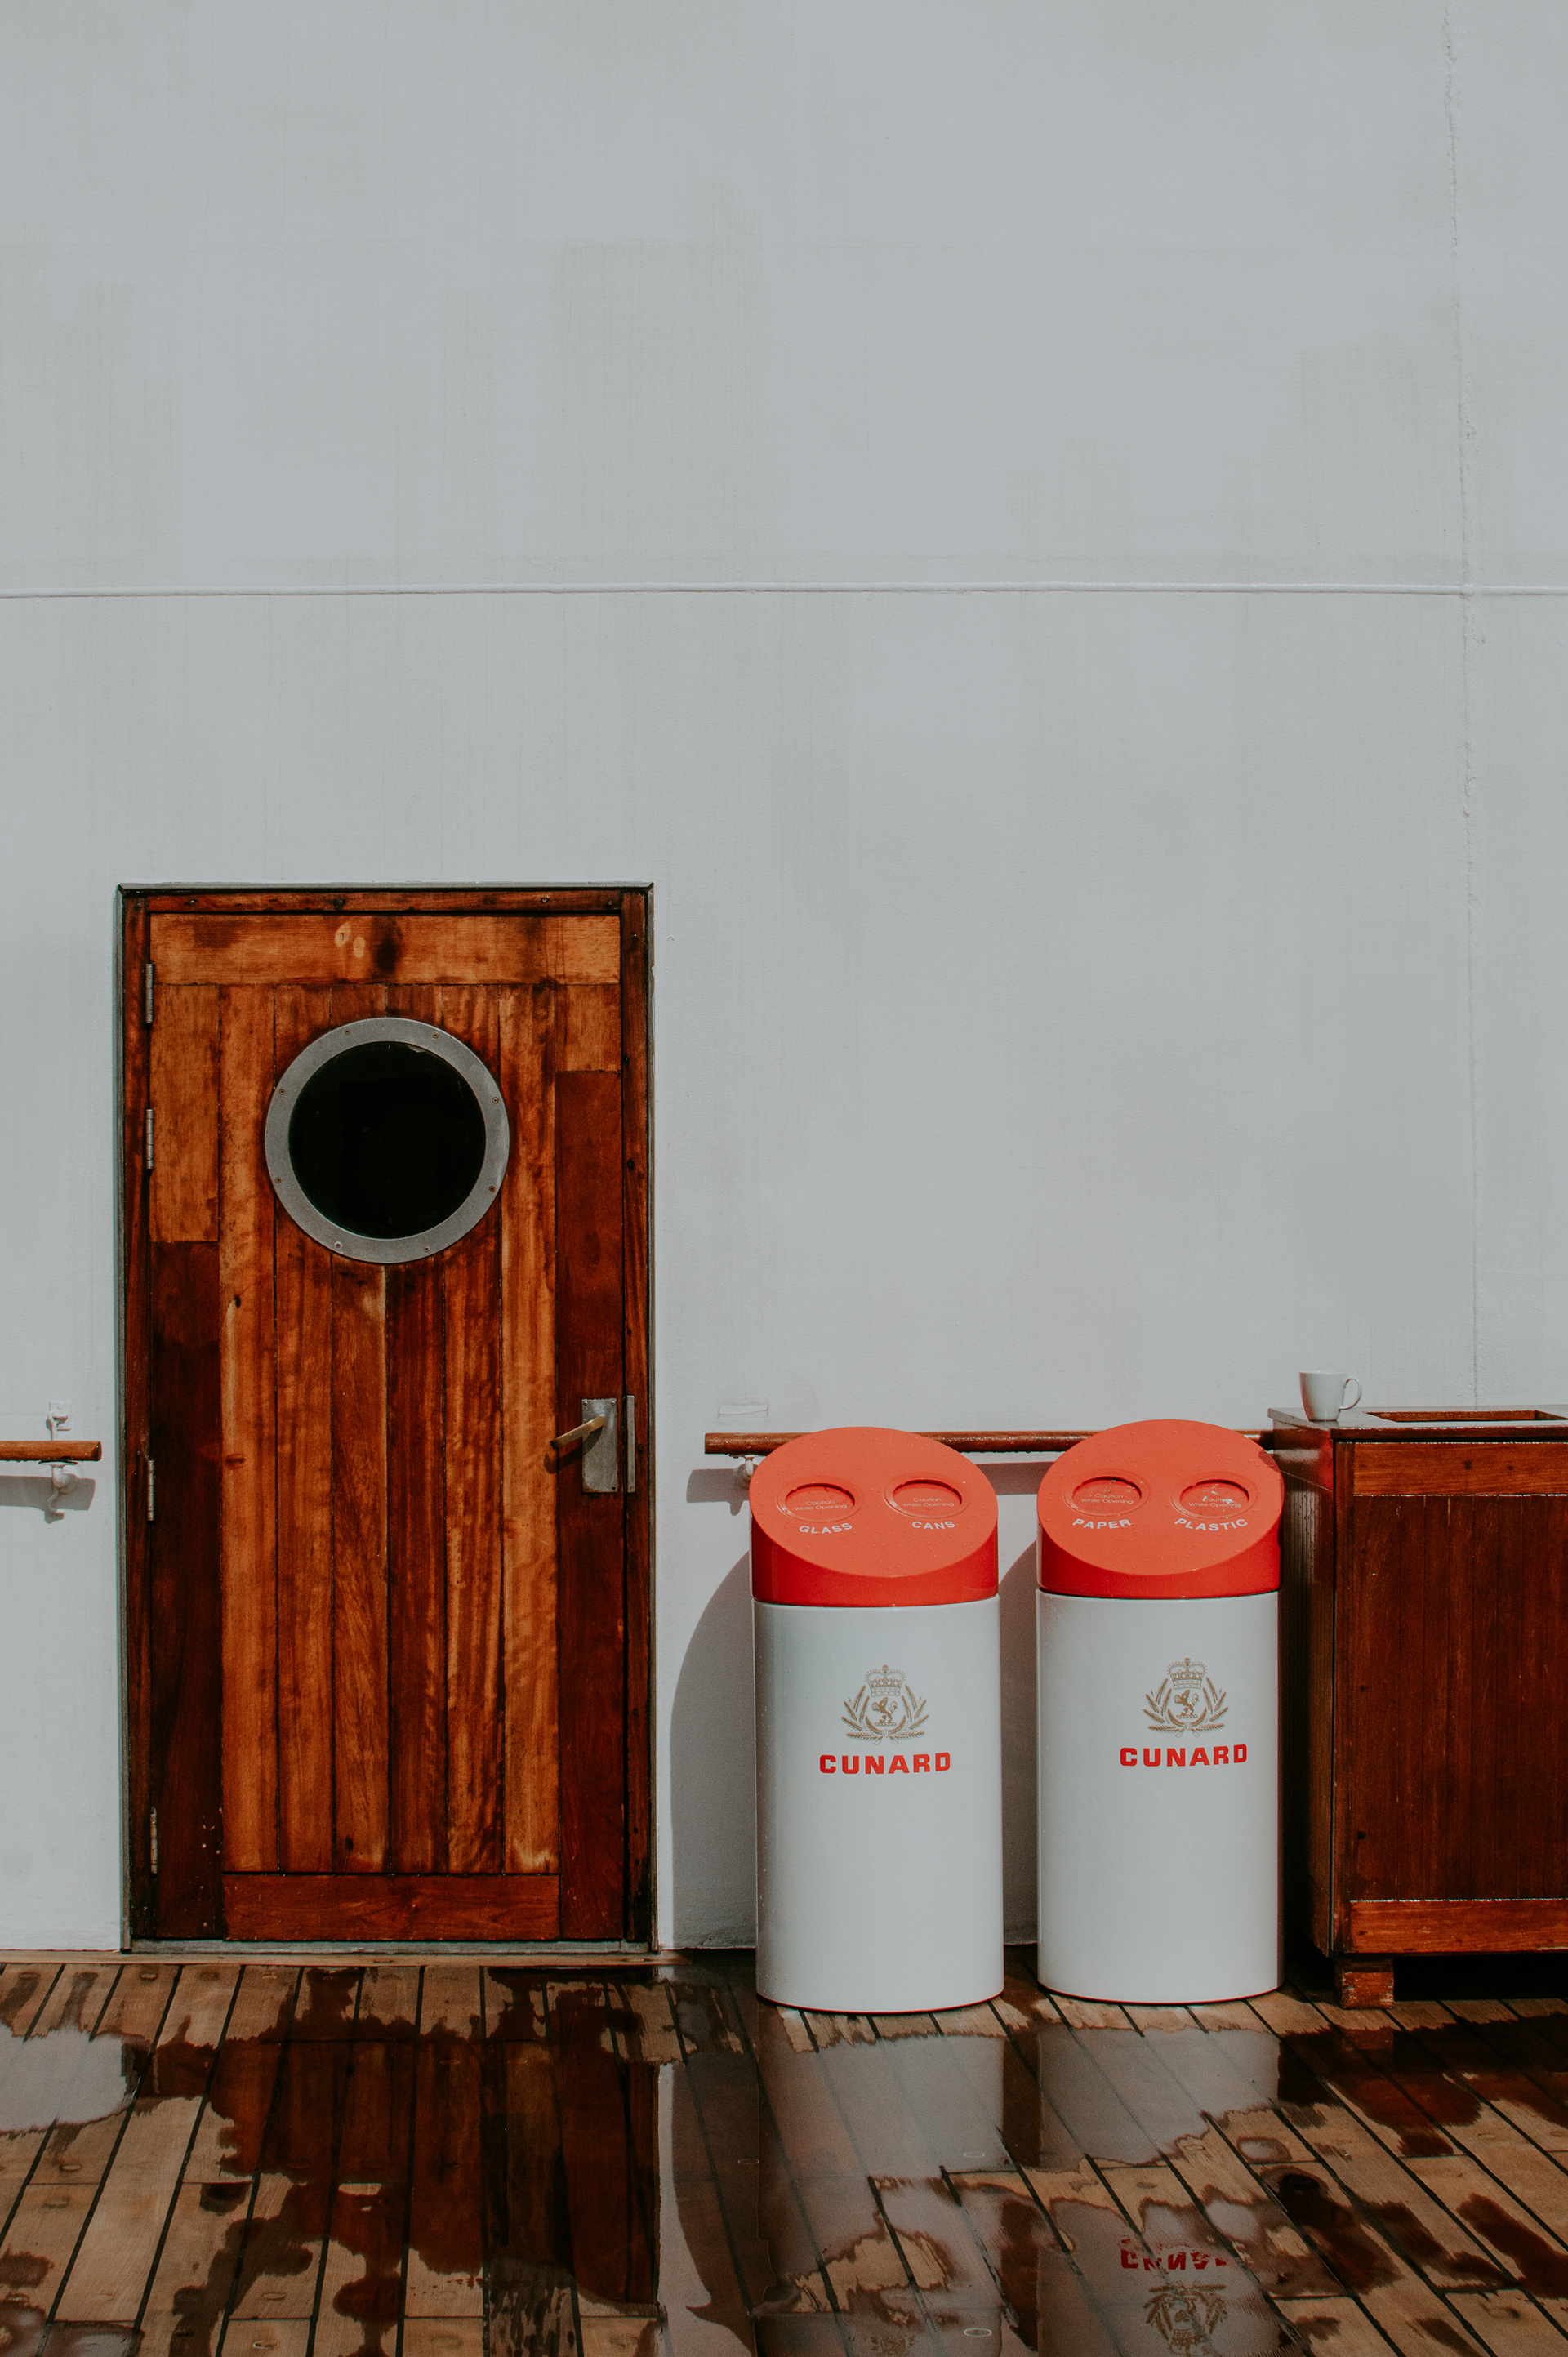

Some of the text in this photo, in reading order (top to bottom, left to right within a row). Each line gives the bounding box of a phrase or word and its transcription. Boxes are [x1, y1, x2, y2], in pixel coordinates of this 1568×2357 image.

[799, 1522, 853, 1534] GLASS
[911, 1521, 956, 1530] CANS
[1072, 1518, 1131, 1530] PAPER
[1174, 1517, 1248, 1531] PLASTIC
[1120, 1744, 1248, 1767] CUNARD
[819, 1752, 951, 1775] CUNARD
